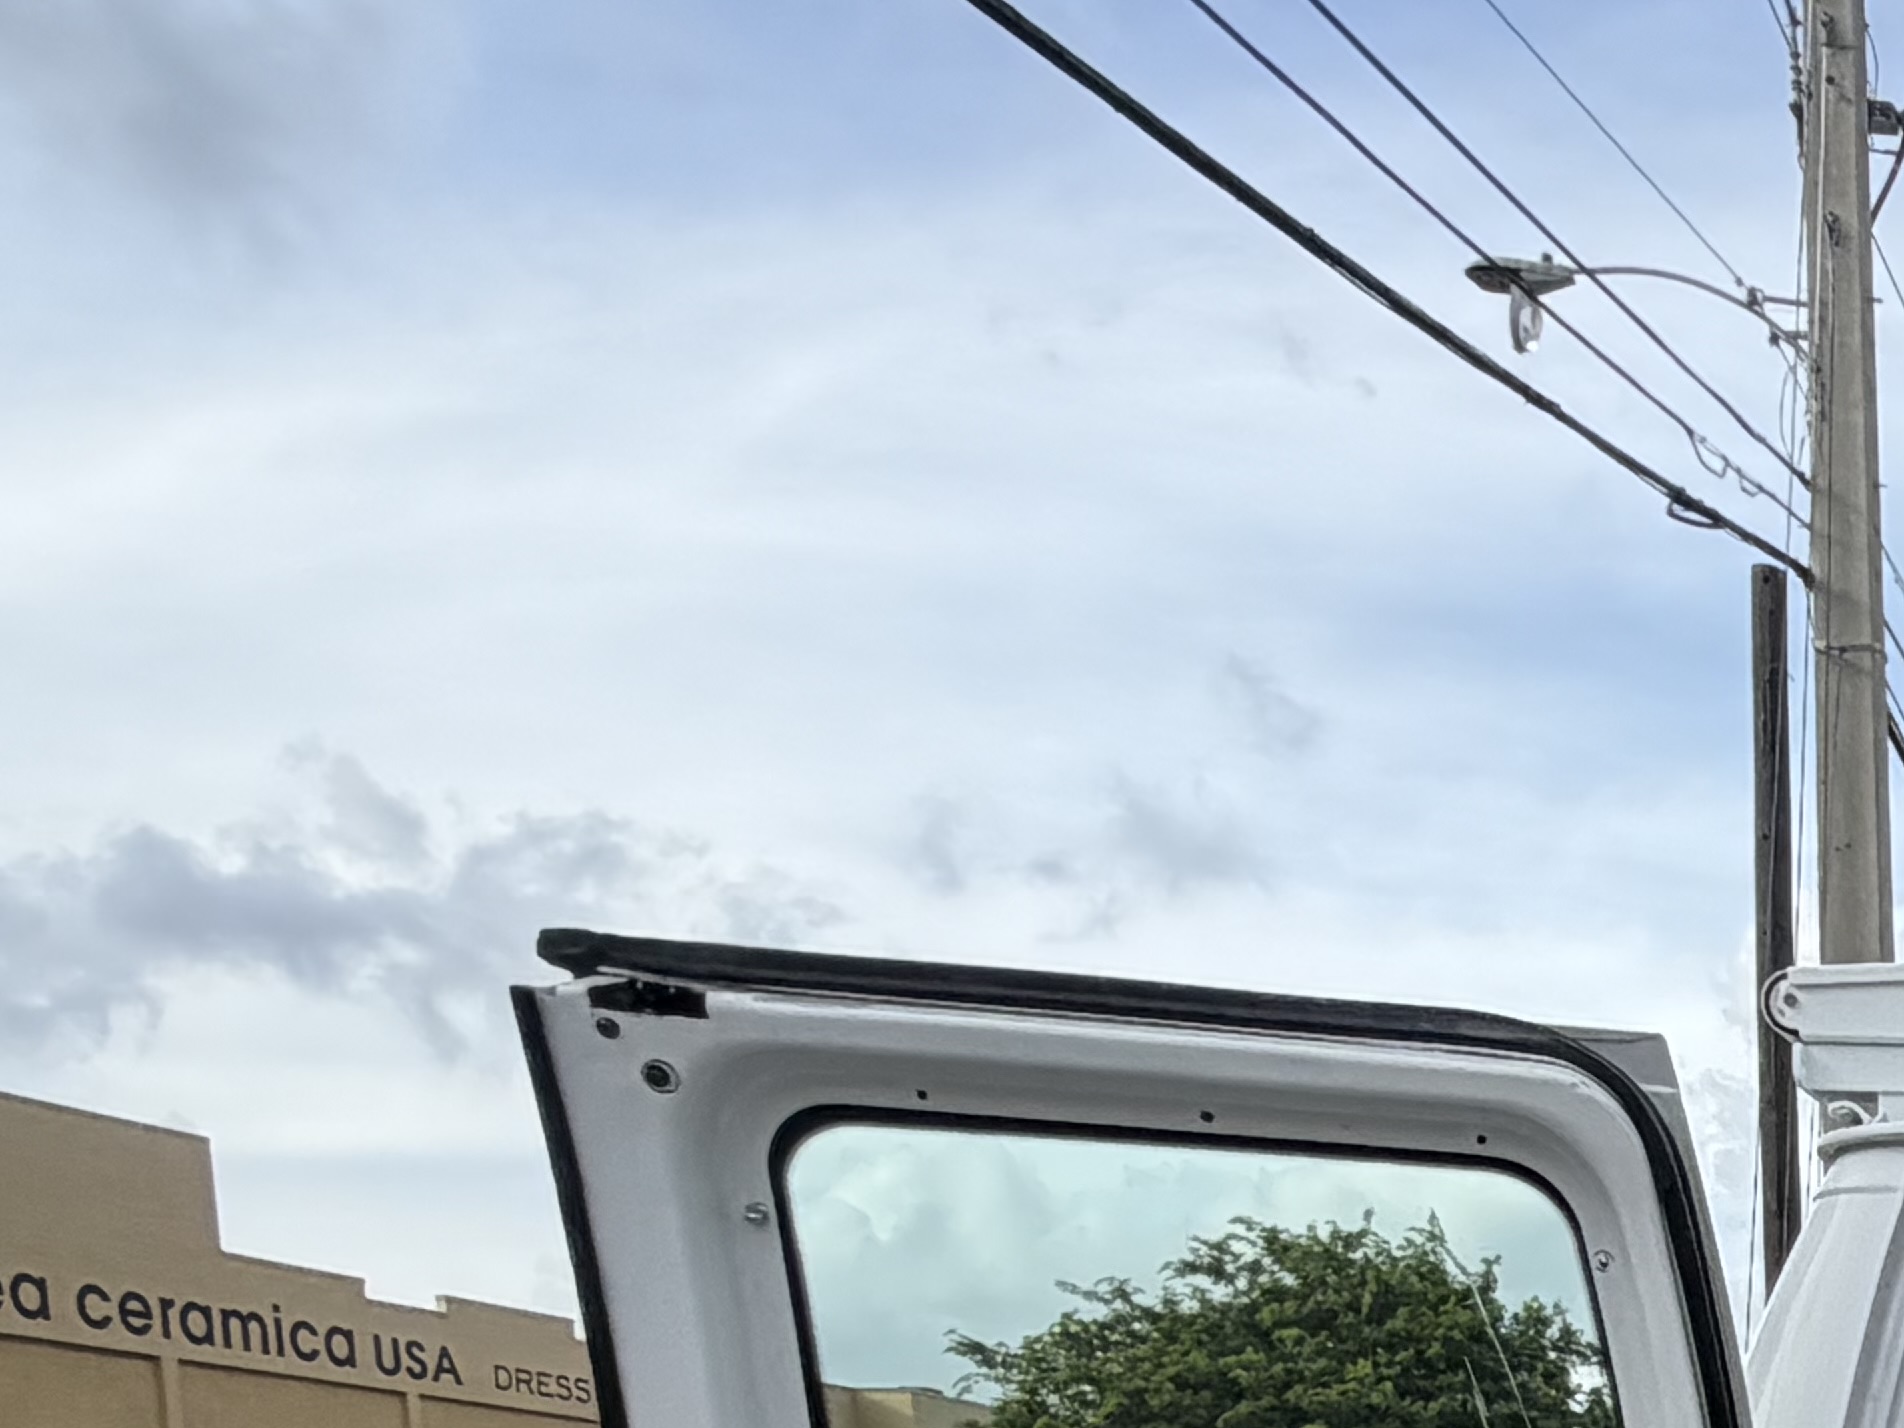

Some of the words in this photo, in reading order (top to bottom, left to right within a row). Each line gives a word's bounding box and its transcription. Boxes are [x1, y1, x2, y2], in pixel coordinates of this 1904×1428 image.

[76, 1283, 357, 1369] ceramica
[372, 1333, 463, 1386] USA
[493, 1364, 592, 1404] DRESS
